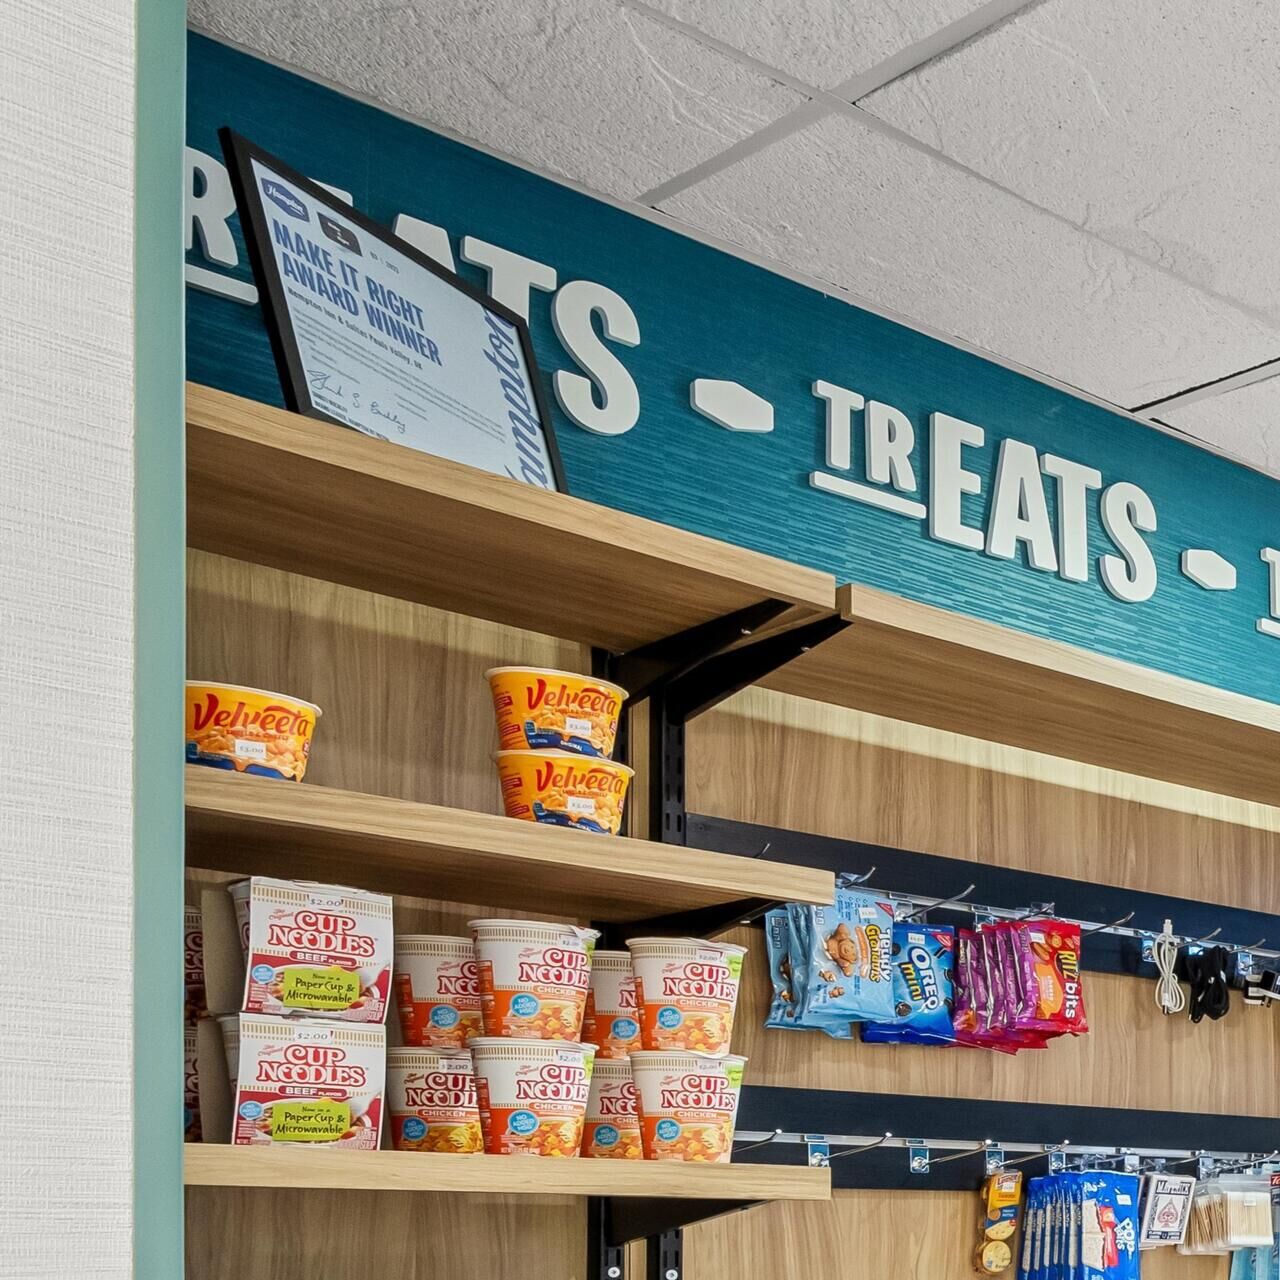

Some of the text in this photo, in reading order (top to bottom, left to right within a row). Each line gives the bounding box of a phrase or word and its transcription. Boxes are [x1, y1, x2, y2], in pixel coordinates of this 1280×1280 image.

[272, 218, 336, 278] MAKE
[339, 259, 359, 292] IT
[365, 276, 425, 331] RIGHT
[281, 252, 443, 366] AWARD WINNER
[482, 302, 557, 491] ampton
[811, 380, 1158, 602] TREATS
[526, 679, 617, 716] Velveeta
[193, 693, 310, 737] Velveeta
[535, 761, 624, 794] Velveeta
[309, 898, 343, 908] $2.00
[294, 911, 356, 934] CUP
[268, 925, 375, 957] NOODLES
[296, 952, 327, 963] BEEF
[543, 948, 589, 971] CUP
[1056, 950, 1080, 983] RITZ
[683, 963, 730, 981] CUP
[899, 962, 923, 1002] mini
[907, 946, 940, 1011] OREO
[295, 976, 355, 993] Paper Cup &
[537, 986, 577, 996] CHICKEN
[663, 977, 736, 1000] NOODLES
[286, 988, 353, 1005] Microwavable
[679, 999, 719, 1007] CHICKEN
[1065, 982, 1079, 1019] bits
[296, 1031, 329, 1041] $2.00
[284, 1044, 346, 1067] CUP
[256, 1062, 367, 1088] NOODLES
[540, 1065, 587, 1085] CUP
[681, 1075, 729, 1094] CUP
[285, 1086, 317, 1096] BEEF
[661, 1089, 736, 1110] NOODLES
[422, 1109, 467, 1118] CHICKEN
[533, 1102, 575, 1112] CHICKEN
[677, 1111, 718, 1119] CHICKEN
[275, 1121, 343, 1135] Microwavable
[284, 1111, 346, 1126] Paper Cup &
